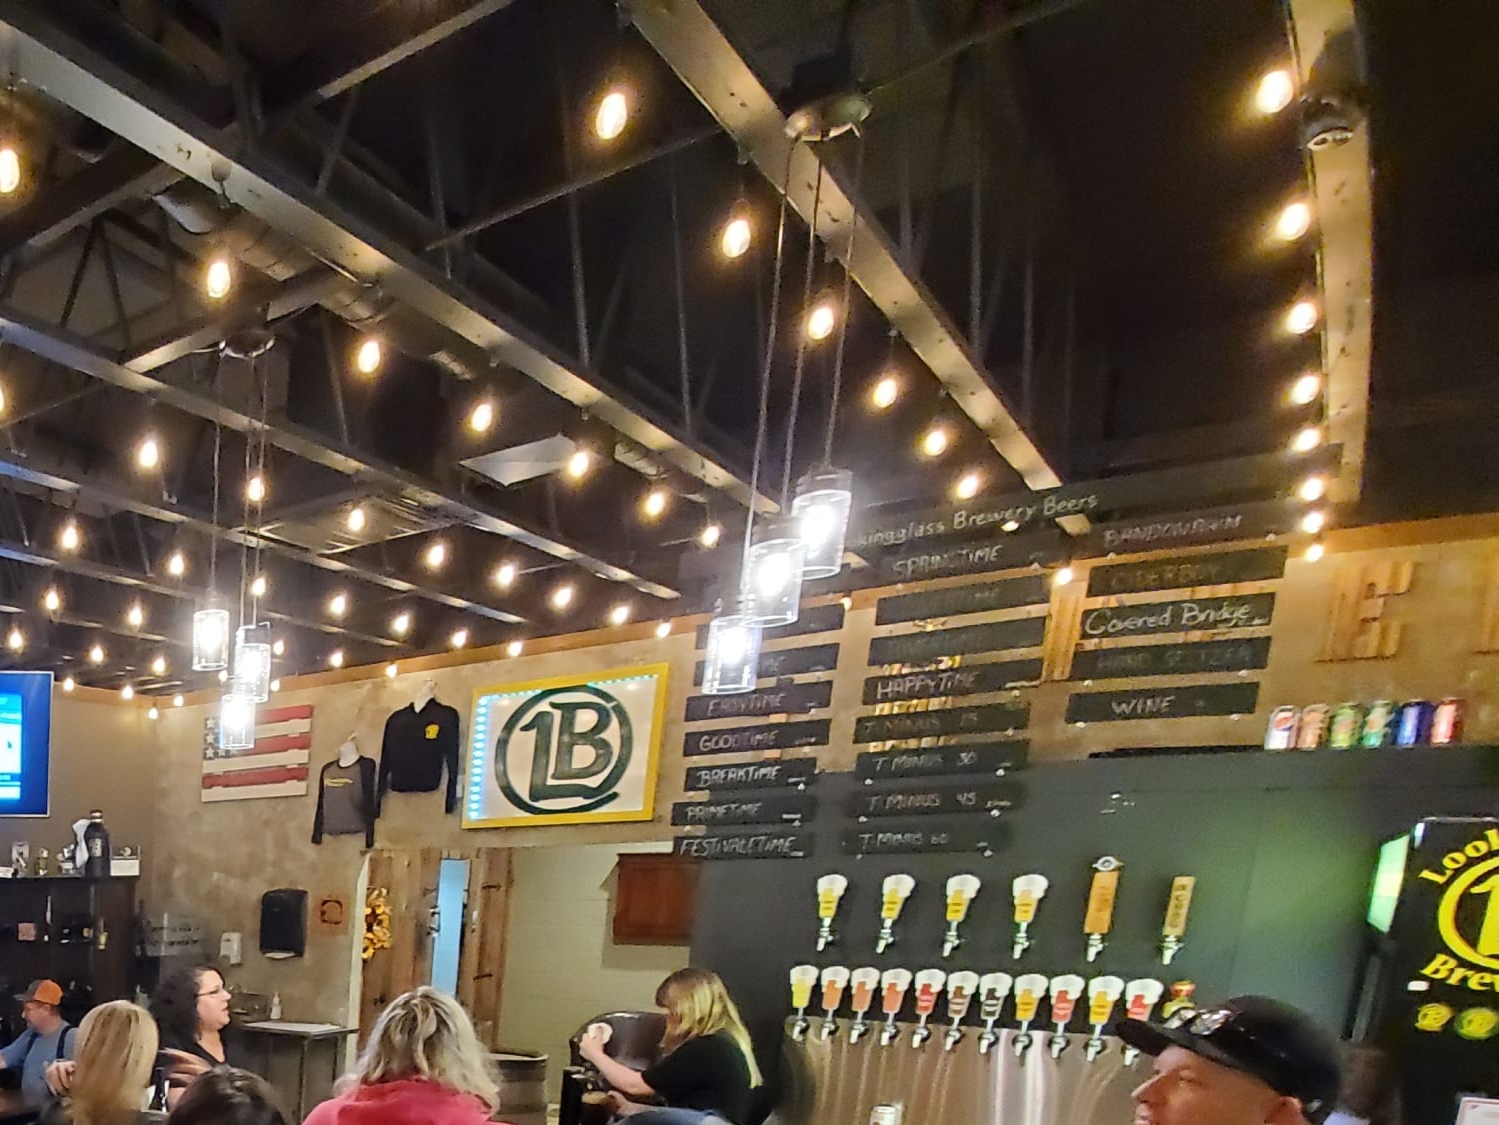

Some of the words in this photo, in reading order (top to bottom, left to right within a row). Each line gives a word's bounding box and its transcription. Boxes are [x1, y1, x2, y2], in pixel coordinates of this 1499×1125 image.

[954, 505, 1037, 530] Brewery
[1043, 494, 1098, 516] Beers
[1110, 695, 1176, 715] WINE
[696, 765, 782, 788] BREAKTIME
